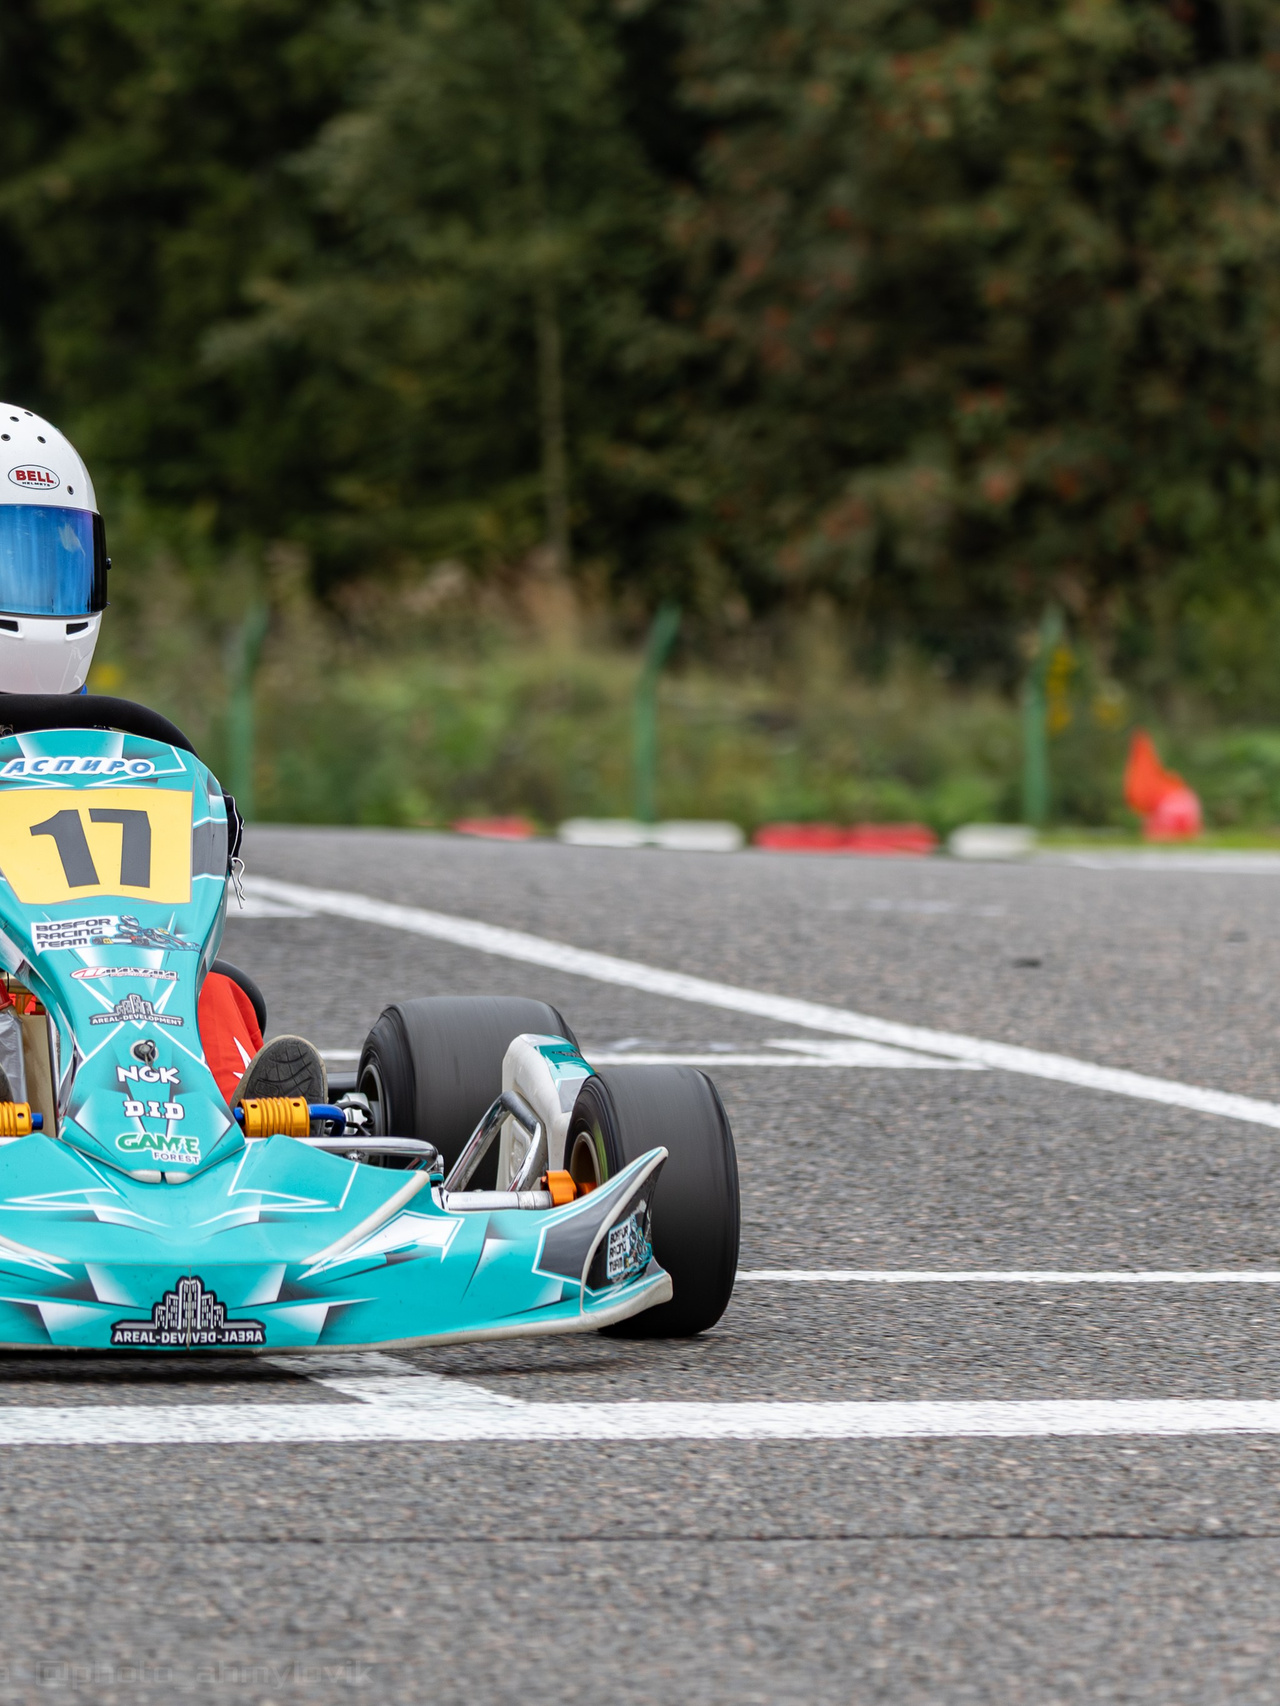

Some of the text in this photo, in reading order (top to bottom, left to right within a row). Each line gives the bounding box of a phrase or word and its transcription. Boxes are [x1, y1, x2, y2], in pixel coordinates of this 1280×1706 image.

[15, 470, 55, 484] BELL
[3, 759, 152, 776] АСПИРО
[29, 808, 152, 888] 17
[36, 918, 113, 932] BOSFOR
[36, 927, 104, 941] RACING
[37, 937, 88, 949] TEAM
[92, 1013, 183, 1026] AREAL-DEVELOPMENT
[116, 1065, 181, 1085] NGK
[117, 1133, 199, 1155] GAME
[154, 1152, 200, 1164] FOREST
